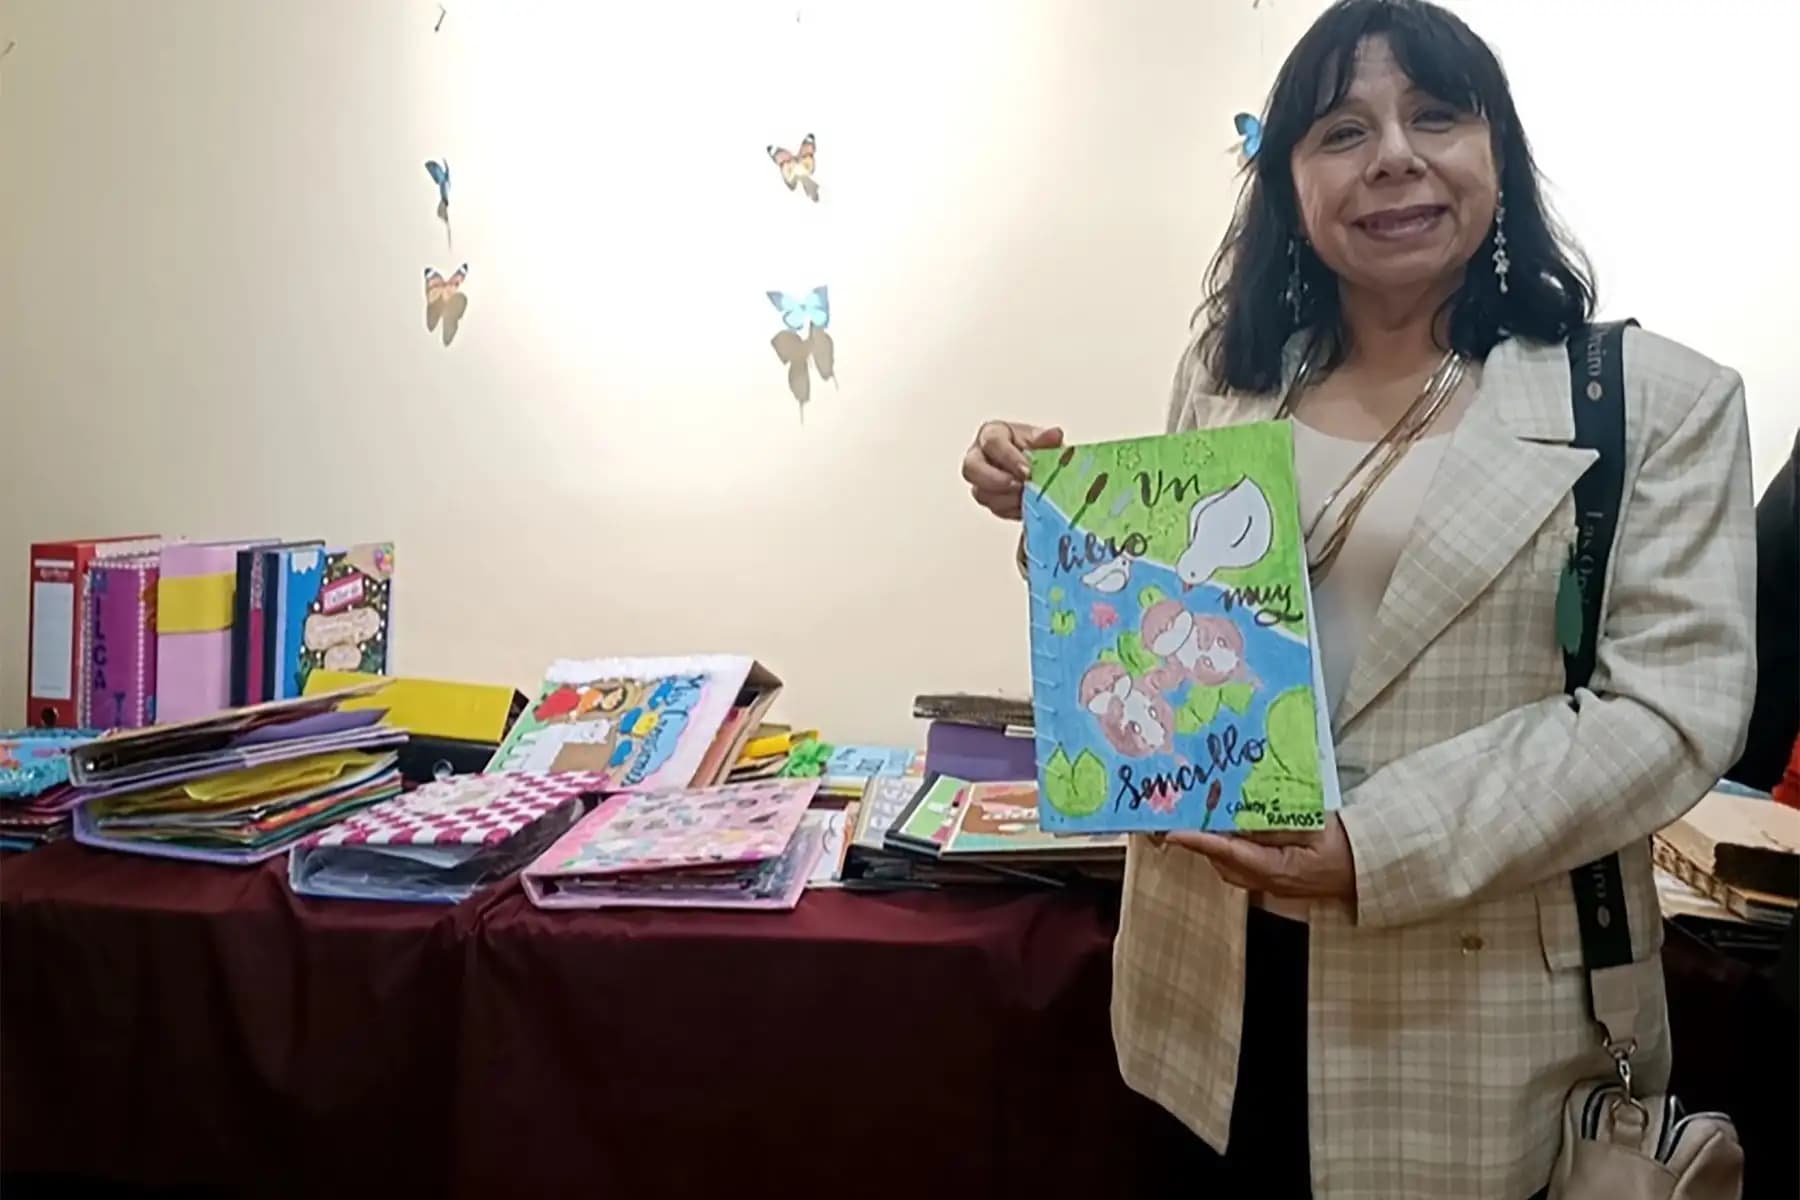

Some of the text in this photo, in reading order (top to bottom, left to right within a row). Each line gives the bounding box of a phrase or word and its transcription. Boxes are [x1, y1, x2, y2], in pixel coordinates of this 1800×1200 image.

[1132, 469, 1201, 508] Un
[1053, 531, 1153, 578] libro
[1216, 584, 1304, 627] muy
[1114, 723, 1267, 814] Sencillo
[1266, 811, 1315, 827] RAMOS
